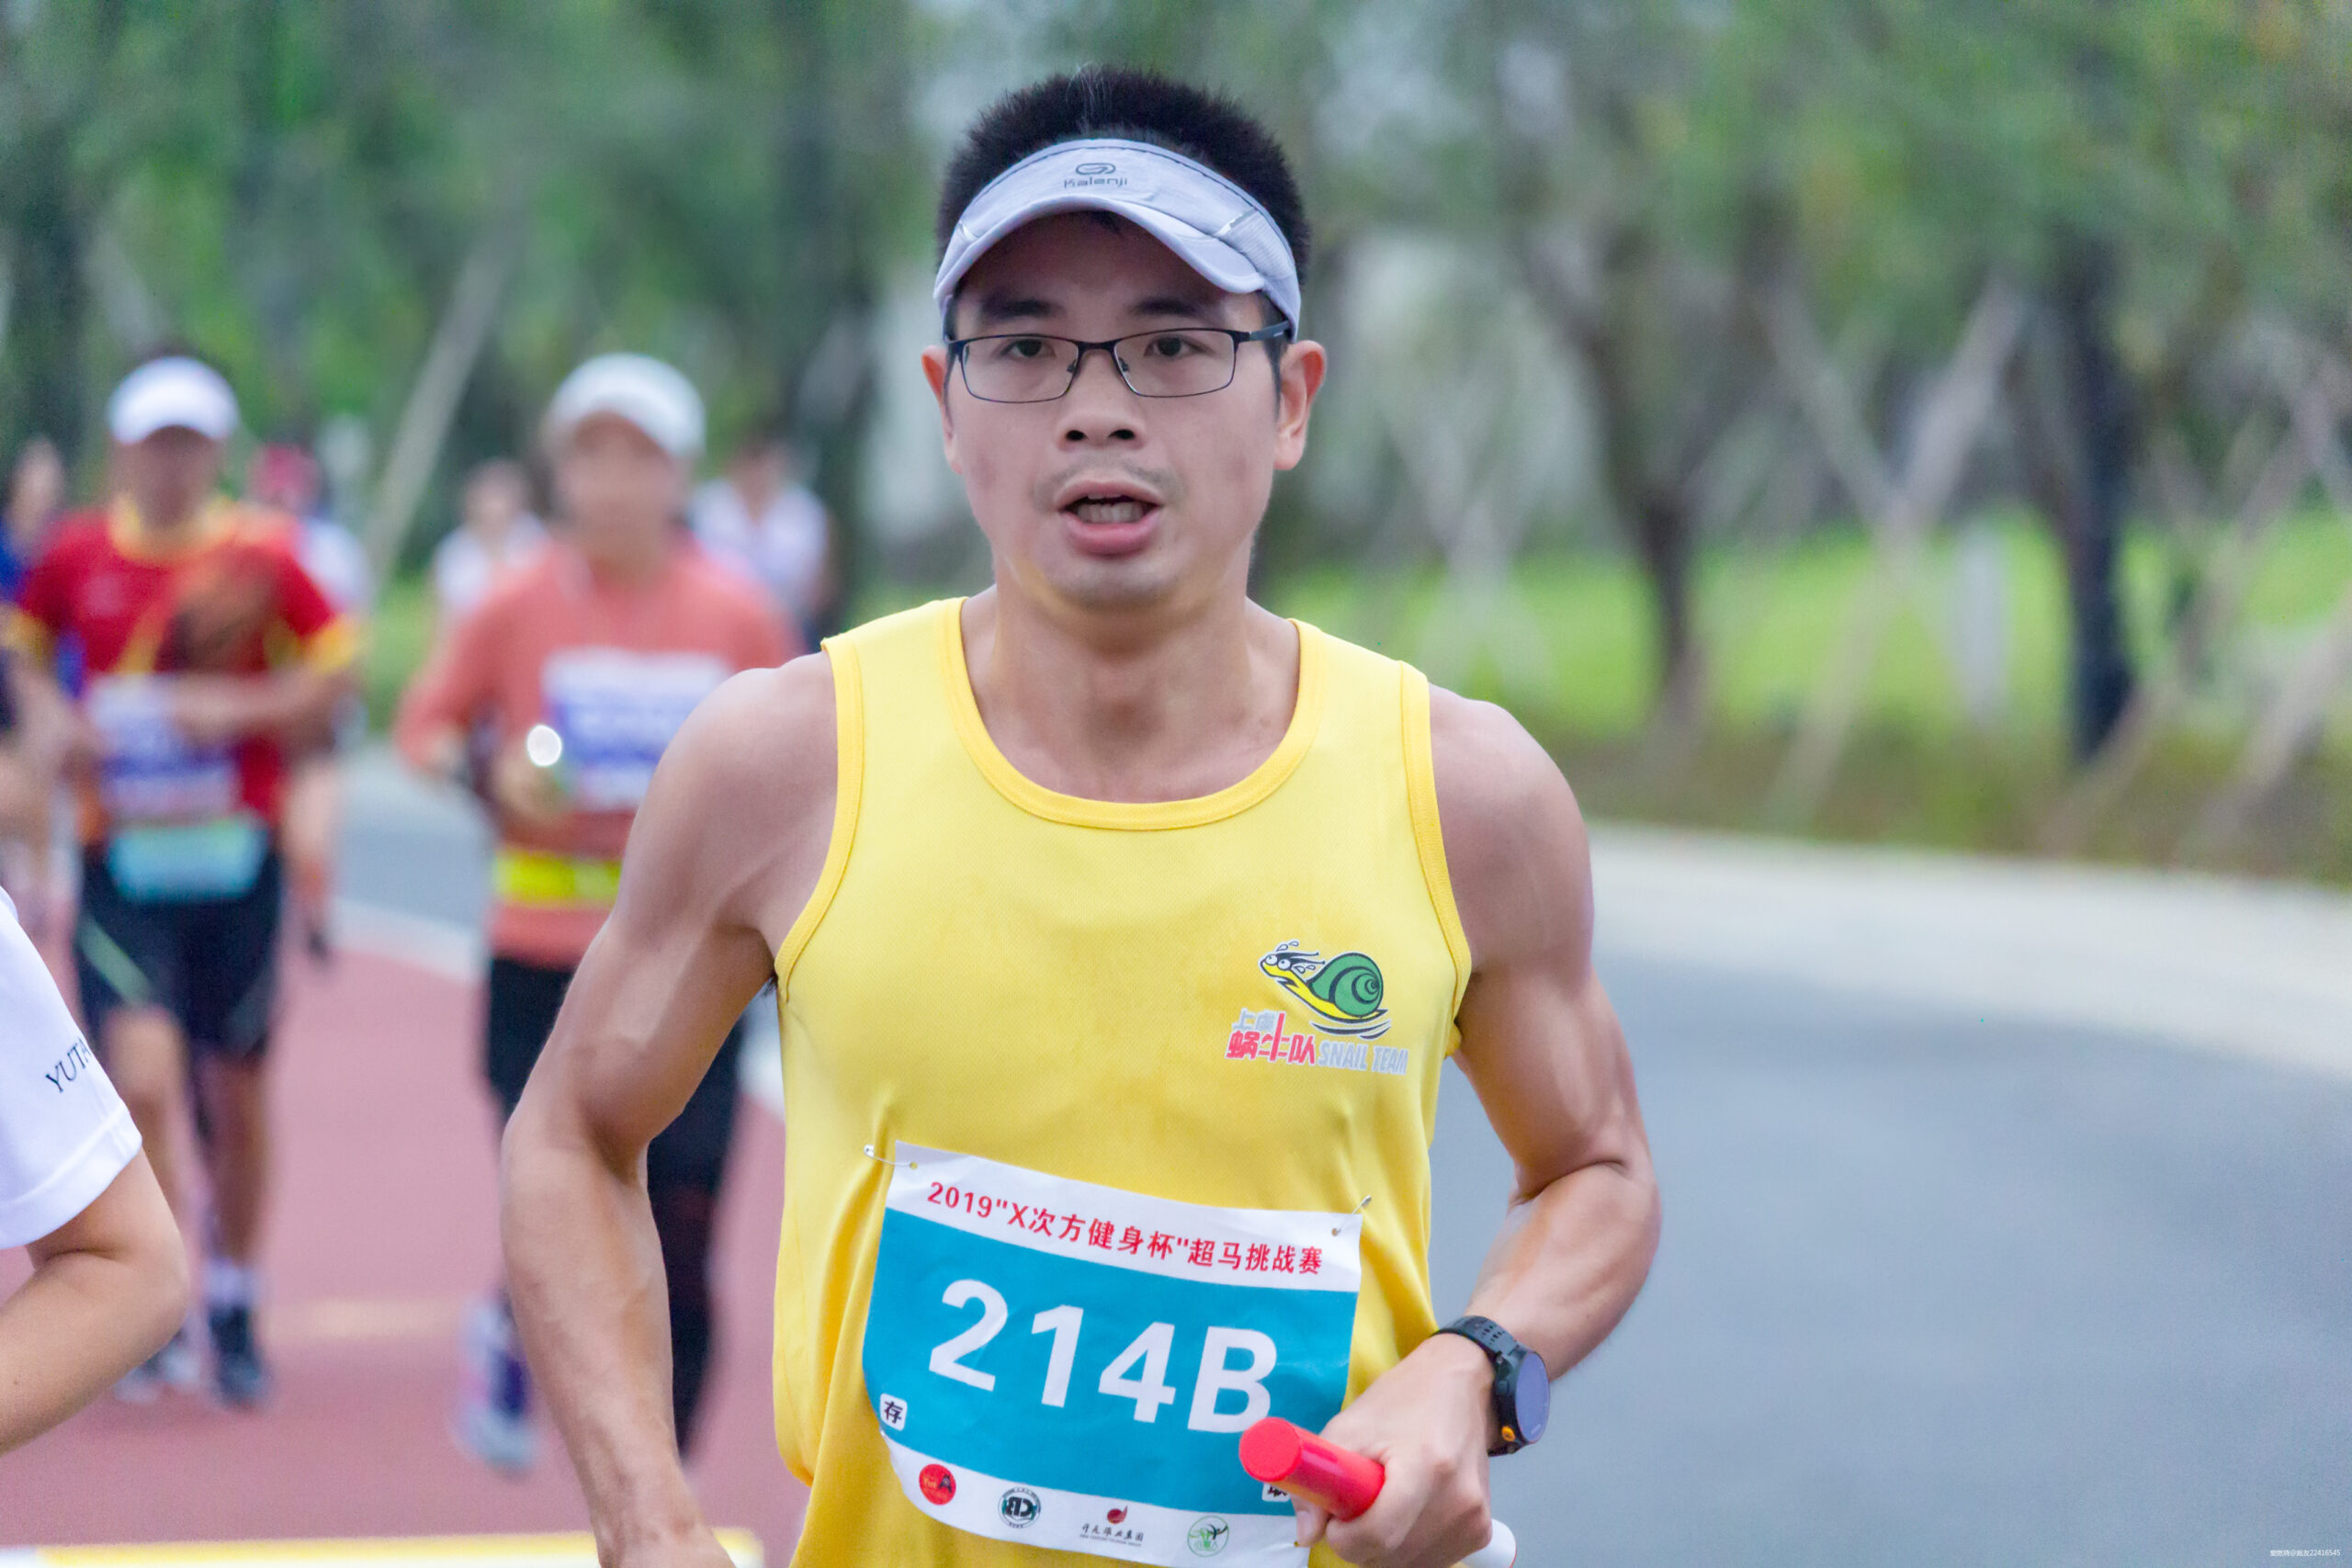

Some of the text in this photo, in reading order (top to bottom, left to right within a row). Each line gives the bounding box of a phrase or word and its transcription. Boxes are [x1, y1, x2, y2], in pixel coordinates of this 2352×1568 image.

[1064, 176, 1127, 187] Kalenji
[1226, 1011, 1316, 1066] 蜗牛队
[1317, 1039, 1408, 1076] SNAIL TEAM
[928, 1278, 1277, 1434] 214B
[884, 1400, 903, 1424] 存
